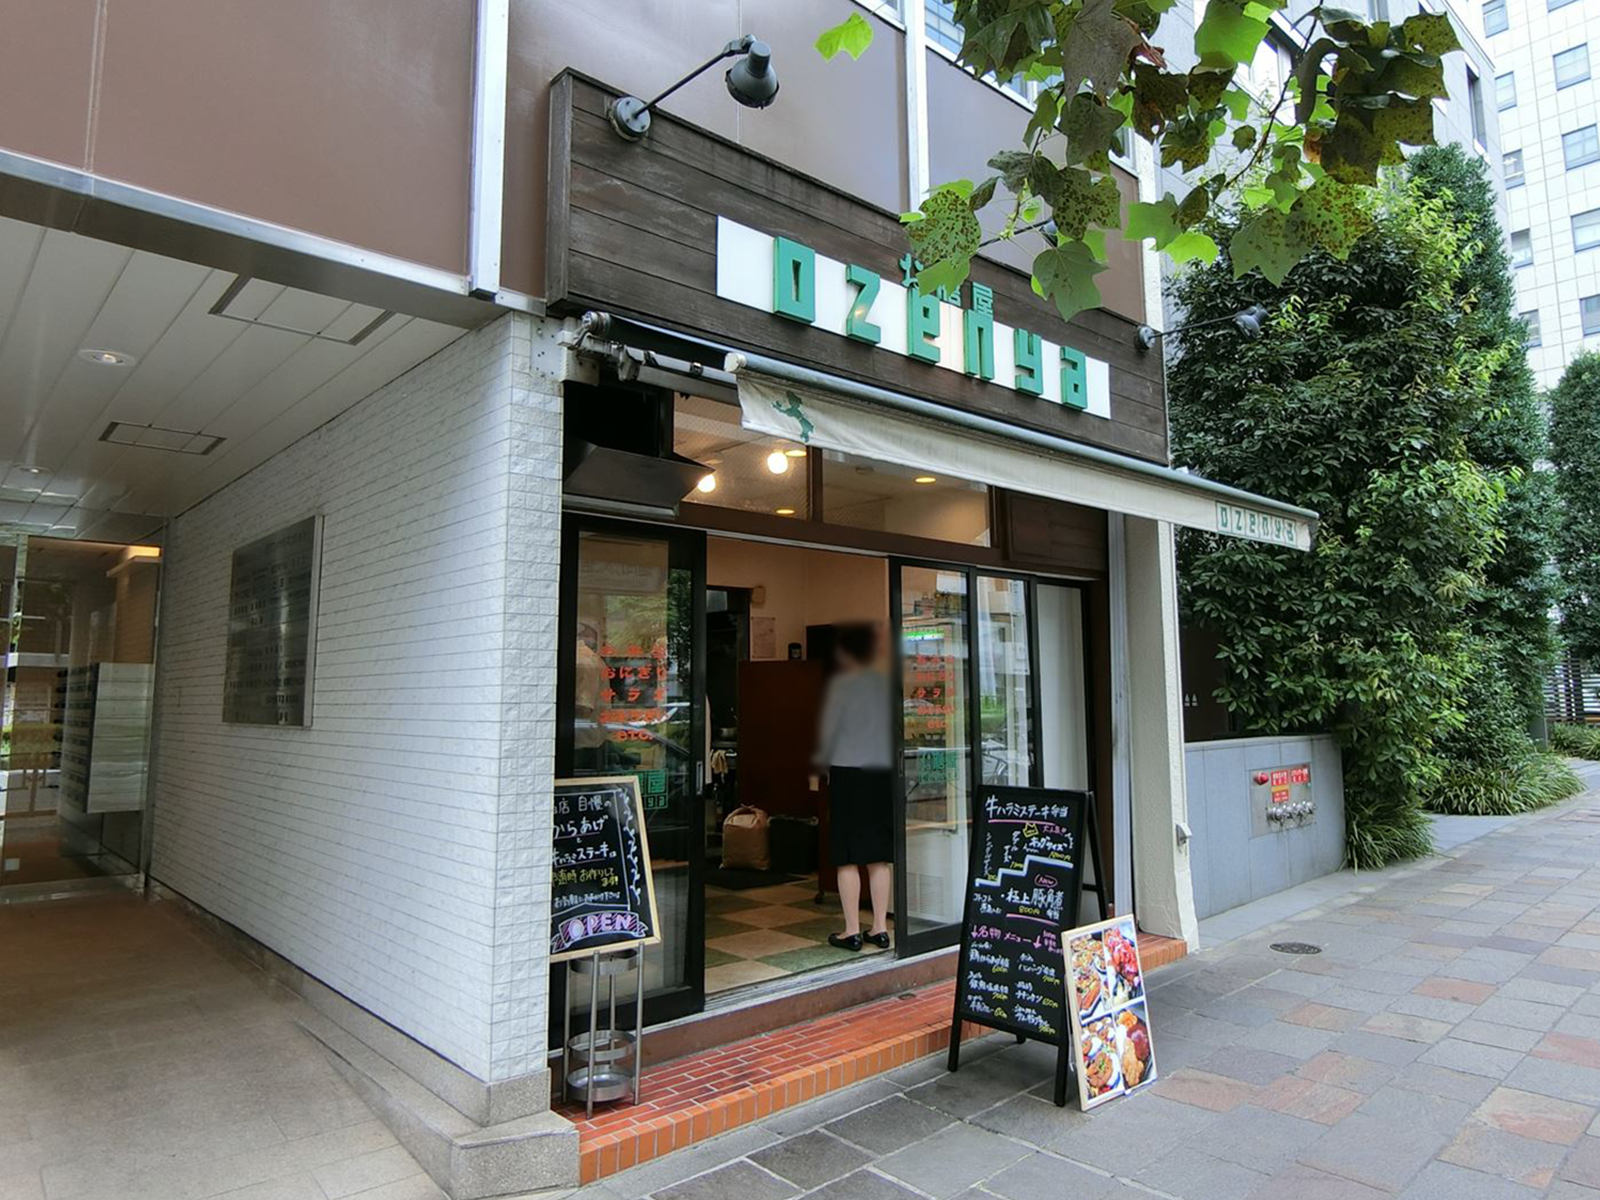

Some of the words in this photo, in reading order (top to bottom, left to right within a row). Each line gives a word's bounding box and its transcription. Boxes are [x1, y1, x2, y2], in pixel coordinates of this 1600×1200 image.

[601, 663, 667, 681] おにぎり
[578, 794, 612, 812] 自慢の
[985, 794, 1069, 820] 牛ハラミステーキ弁当
[569, 912, 632, 940] OPEN
[977, 925, 1002, 940] 名物
